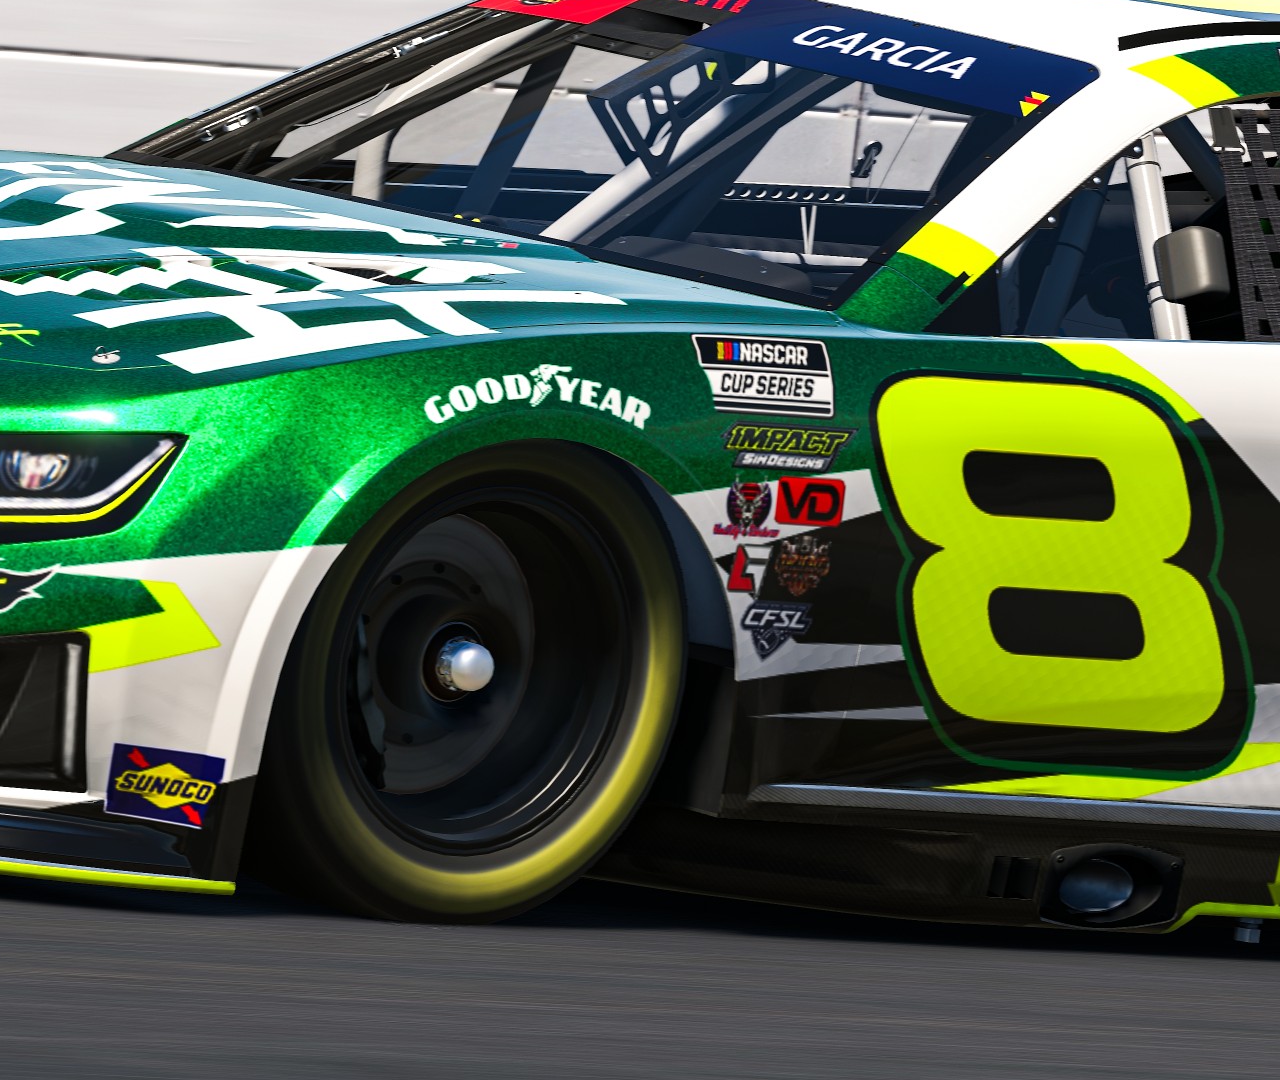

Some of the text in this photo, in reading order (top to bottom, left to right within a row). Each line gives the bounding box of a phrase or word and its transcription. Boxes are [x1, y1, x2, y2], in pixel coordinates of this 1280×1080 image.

[792, 24, 977, 81] GARCIA
[739, 342, 809, 366] NASCAR
[721, 373, 816, 398] CUP SERIES
[726, 425, 849, 456] IMPACT
[876, 375, 1226, 734] 8
[743, 608, 807, 629] CFSL
[118, 773, 213, 801] SUNOCO
